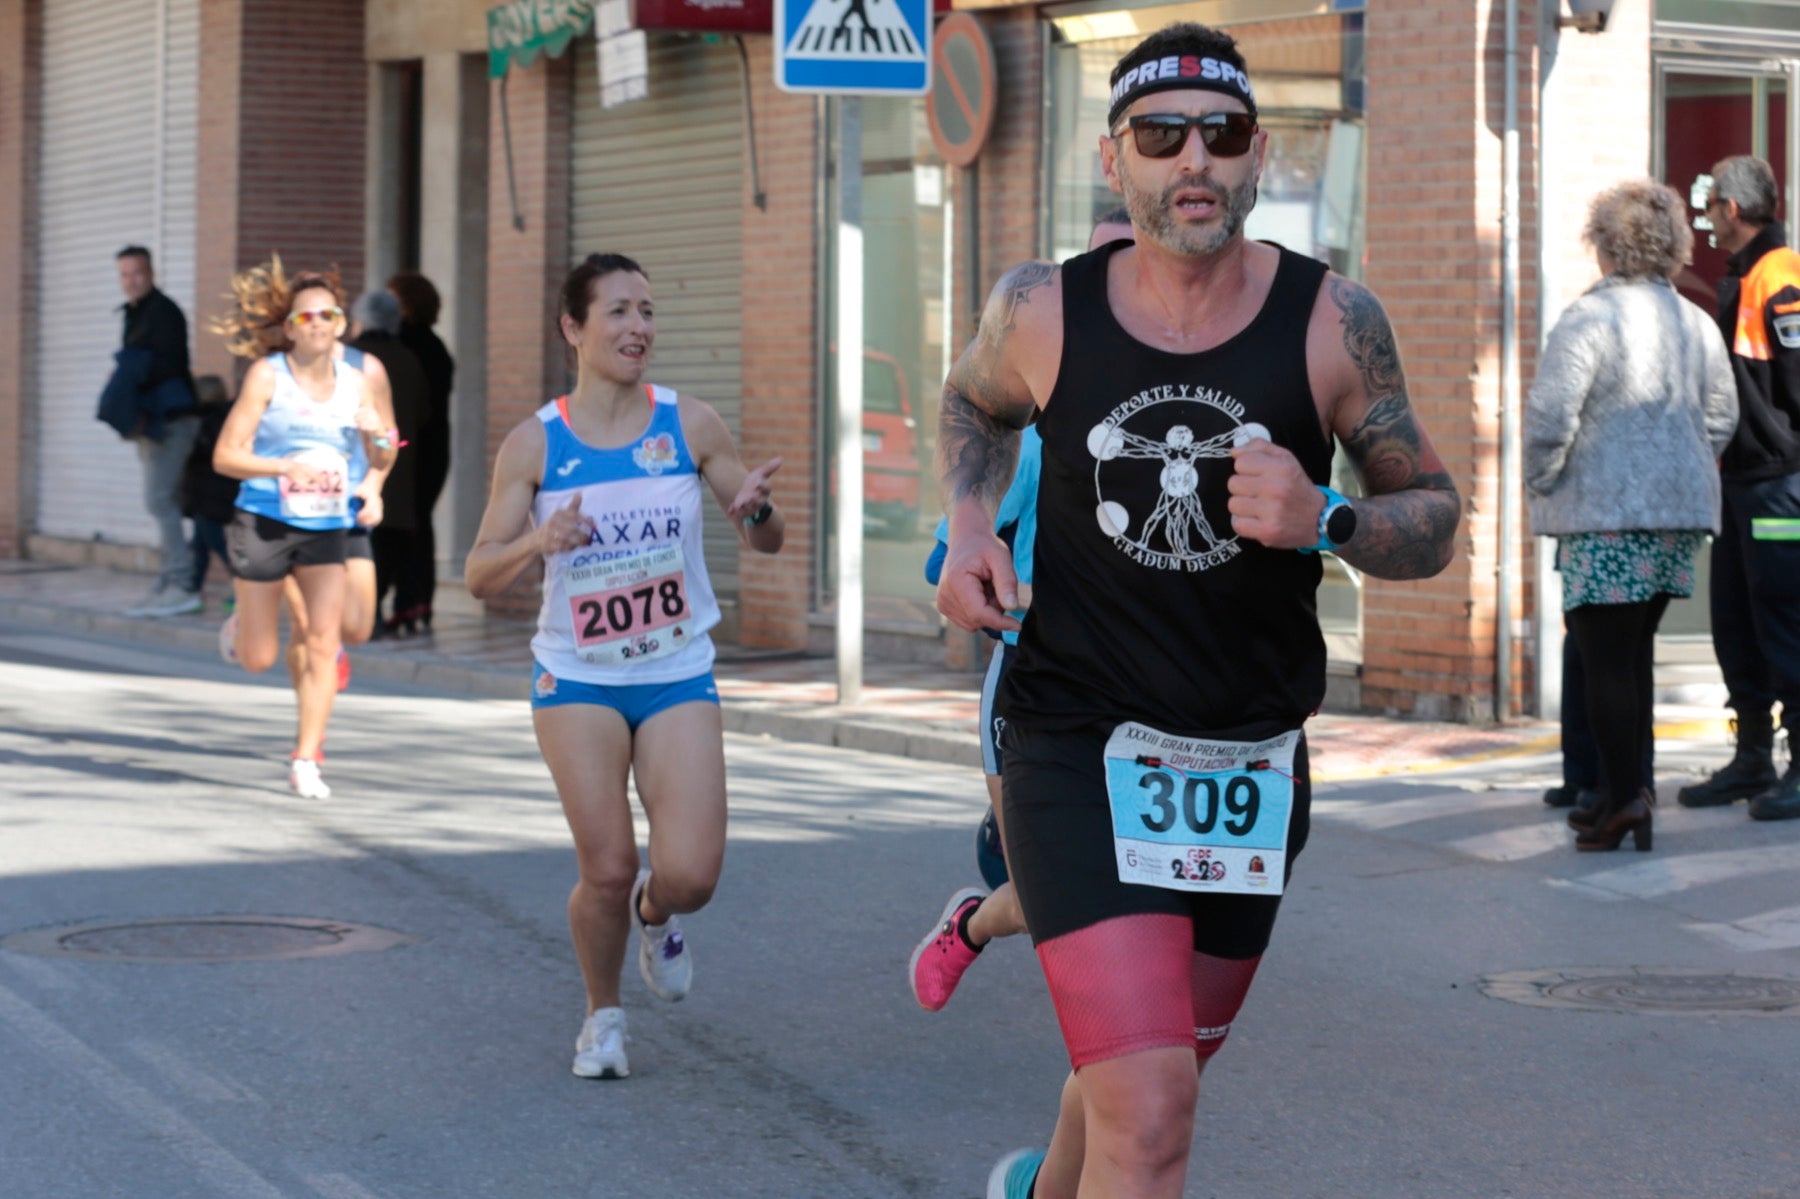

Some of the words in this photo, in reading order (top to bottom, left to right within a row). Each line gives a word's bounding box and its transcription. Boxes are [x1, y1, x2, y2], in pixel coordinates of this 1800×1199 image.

[1109, 55, 1255, 106] MPRESSPO
[1102, 384, 1175, 427] DEPORTE
[1178, 384, 1191, 398] Y
[1194, 386, 1246, 419] SALUD
[602, 507, 682, 522] ATLETISMO
[1113, 536, 1181, 571] GRADUM
[1186, 541, 1243, 572] DECEM
[578, 580, 684, 640] 2078
[1125, 727, 1159, 745] XXXIII
[1161, 738, 1193, 753] GRAN
[1194, 744, 1235, 757] PREMIO
[1238, 746, 1253, 756] DE
[1138, 771, 1261, 836] 309
